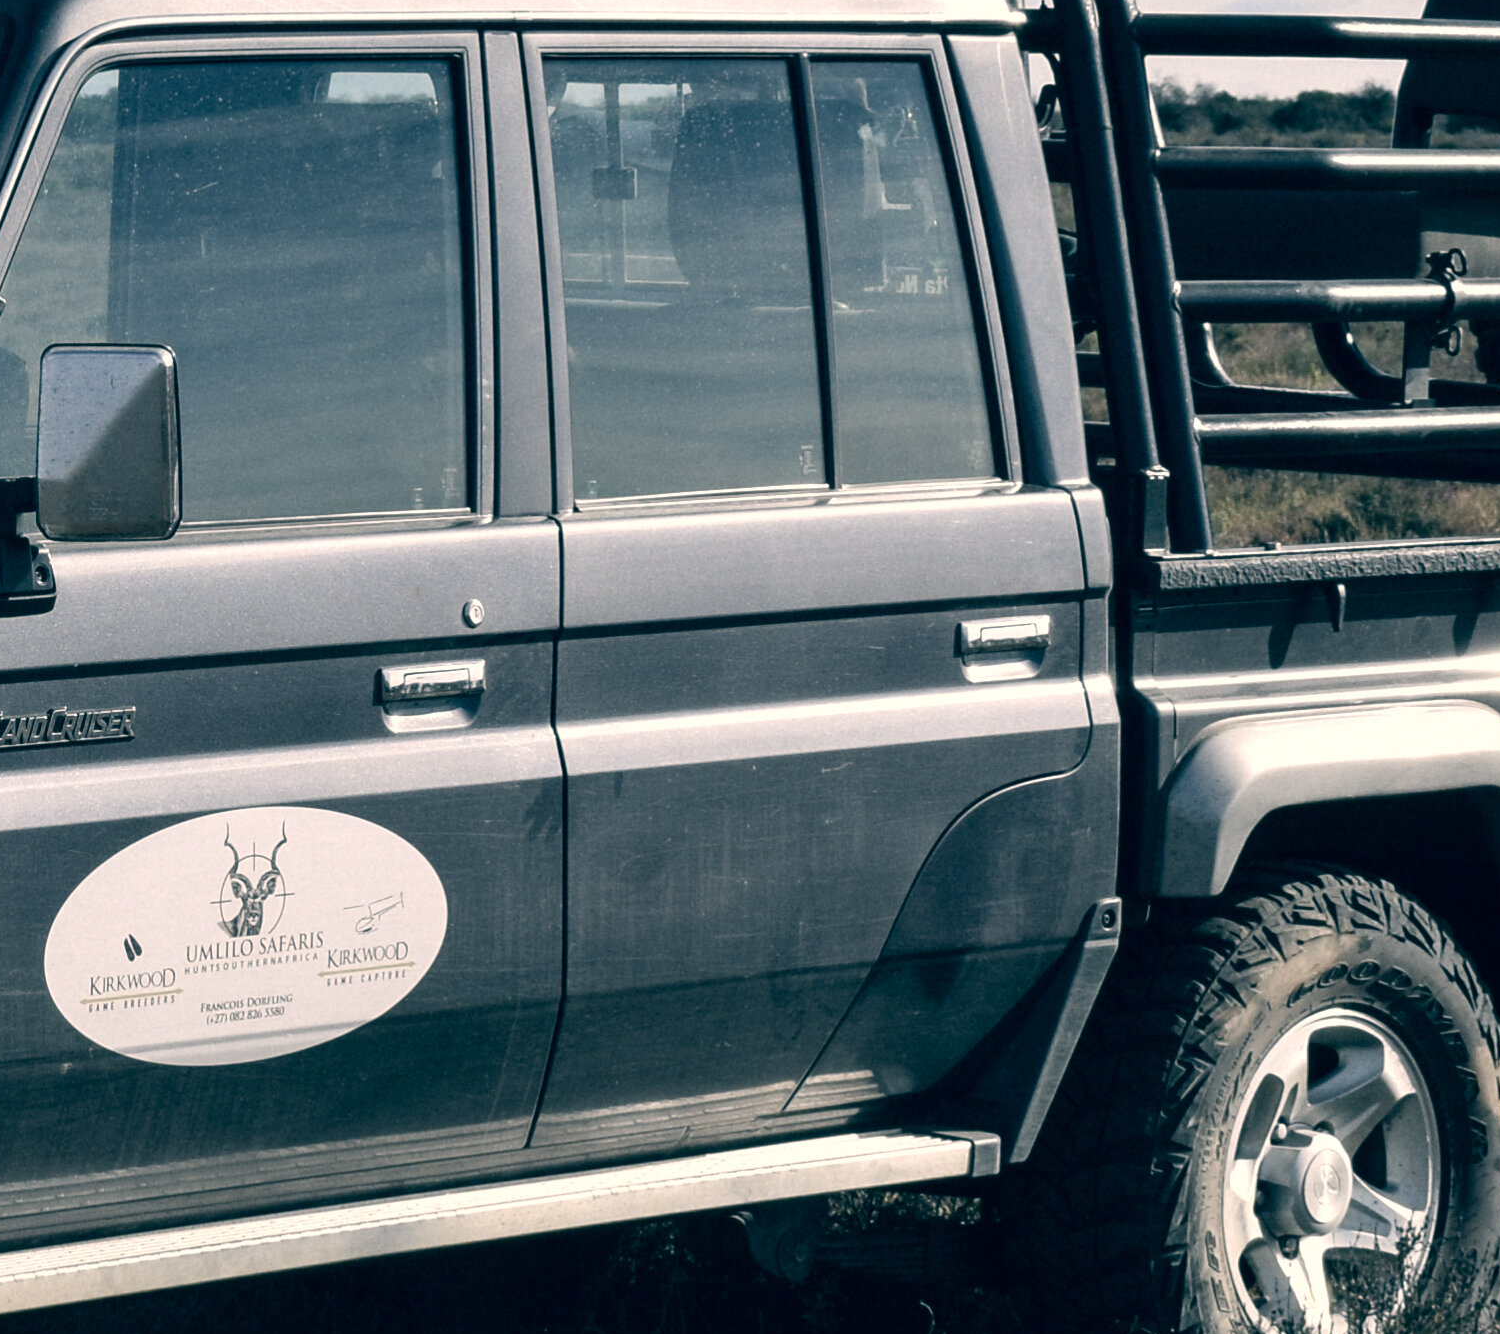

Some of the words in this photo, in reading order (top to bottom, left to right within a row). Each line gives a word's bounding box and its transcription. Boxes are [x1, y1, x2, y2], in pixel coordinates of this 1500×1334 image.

[186, 937, 254, 963] UMLILO
[258, 930, 324, 955] SAFARIS
[327, 941, 408, 969] KIRKWOOD
[90, 967, 176, 996] KIRKWOOD
[327, 975, 353, 987] GAME
[360, 969, 406, 983] CAPTURE
[88, 1001, 115, 1013] GAME
[123, 994, 175, 1010] BREEDERS
[200, 999, 244, 1013] FRANCOIS
[247, 993, 293, 1008] DORFLING
[206, 1013, 228, 1025] (+27)
[229, 1010, 245, 1022] 082
[246, 1008, 263, 1020] 826
